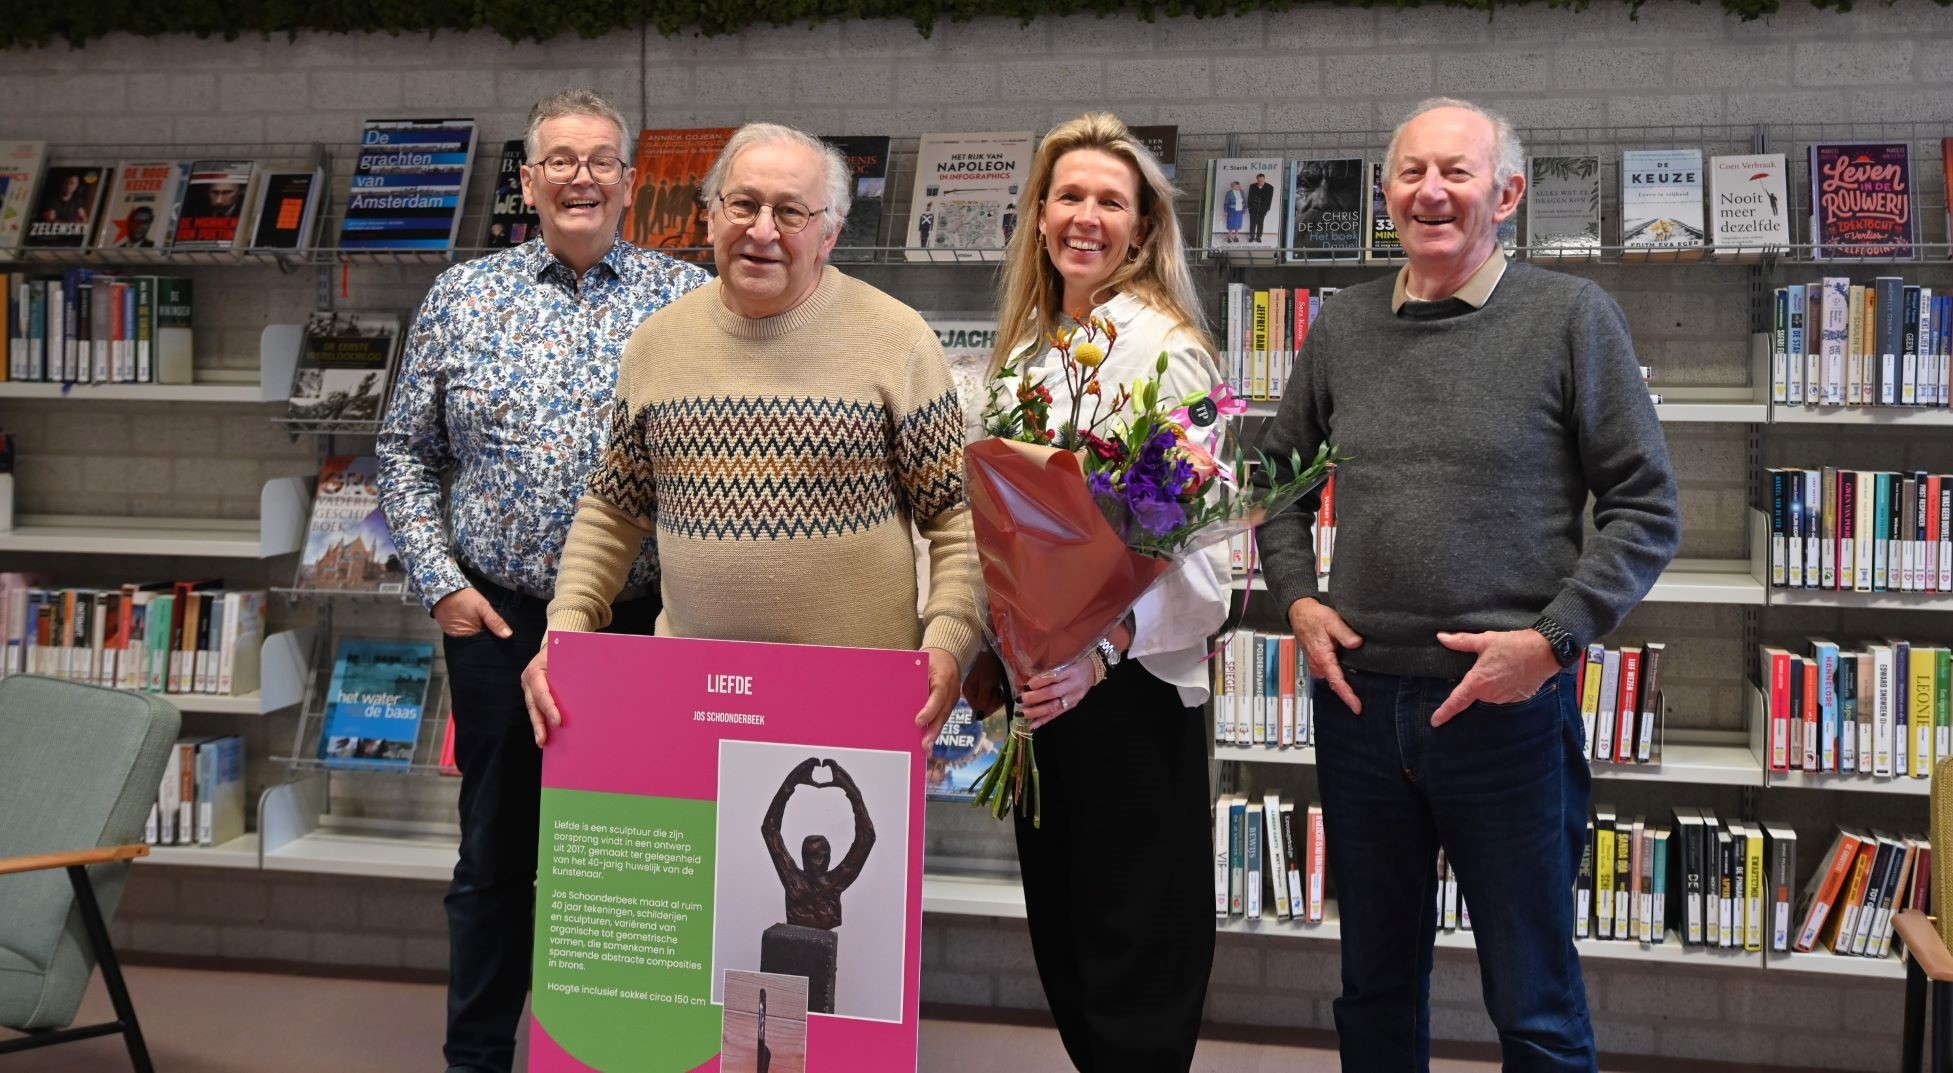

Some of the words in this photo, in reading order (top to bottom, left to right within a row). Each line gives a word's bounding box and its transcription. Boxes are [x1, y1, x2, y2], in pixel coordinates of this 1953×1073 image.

[366, 130, 389, 145] De
[360, 152, 432, 169] grachten
[937, 161, 1016, 172] NAPOLEON
[1251, 162, 1278, 171] Klaar
[950, 172, 1010, 180] INFOGRAPHICS
[1632, 173, 1695, 184] KEUZE
[1823, 155, 1904, 191] Leven
[357, 175, 384, 187] van
[1875, 183, 1891, 191] DE
[351, 193, 443, 208] Amsterdam
[1721, 193, 1763, 204] Nooit
[1721, 208, 1756, 217] meer
[1822, 190, 1909, 224] ROUWERIJ
[1322, 211, 1358, 221] CHRIS
[29, 222, 88, 236] ZELENSKY
[1299, 223, 1313, 232] DE
[1317, 221, 1358, 231] STOOP
[1376, 220, 1394, 230] 33
[1721, 219, 1780, 232] dezelfde
[1310, 232, 1328, 241] Het
[1331, 231, 1358, 240] boek
[1256, 304, 1265, 332] JEFFREY
[1905, 333, 1914, 350] GEEN
[707, 673, 752, 695] LIEFDE
[1225, 661, 1235, 695] SPIEGEL
[337, 690, 359, 703] het
[362, 693, 401, 705] water
[1879, 689, 1887, 717] SNOWDEN
[364, 705, 381, 718] de
[385, 704, 417, 719] baas
[693, 711, 705, 722] JOS
[706, 712, 765, 725] SCHOONDERBEEK
[555, 820, 580, 831] Liefde
[582, 822, 589, 831] is
[591, 825, 607, 833] een
[609, 825, 651, 837] sculptuur
[653, 829, 667, 838] die
[669, 830, 683, 841] zijn
[554, 833, 599, 845] oorsprong
[601, 836, 623, 846] vindt
[625, 838, 633, 847] in
[635, 840, 651, 848] een
[654, 840, 691, 852] ontwerp
[1248, 826, 1256, 858] BEWIJS
[554, 844, 565, 852] uit
[567, 845, 587, 855] 2017,
[589, 847, 629, 858] gemaakt
[631, 851, 642, 859] ter
[645, 851, 701, 864] gelegenheid
[553, 857, 570, 865] van
[572, 856, 586, 866] het
[588, 858, 623, 871] 40-jarig
[625, 861, 661, 873] huwelijk
[663, 865, 679, 874] van
[682, 865, 694, 875] de
[553, 867, 604, 879] kunstenaar.
[1736, 866, 1743, 874] DE
[1688, 874, 1698, 888] DE
[552, 890, 567, 899] Jos
[569, 891, 637, 905] Schoonderbeek
[640, 898, 668, 908] maakt
[671, 900, 680, 909] al
[682, 902, 702, 911] ruim
[552, 901, 562, 909] 40
[564, 903, 581, 913] jaar
[584, 904, 635, 918] tekeningen,
[637, 909, 688, 923] schilderijen
[550, 913, 561, 921] en
[564, 914, 612, 927] sculpturen,
[614, 918, 657, 930] variërend
[659, 923, 676, 932] van
[550, 925, 599, 937] organische
[602, 929, 614, 937] tot
[616, 930, 678, 944] geometrische
[550, 937, 585, 948] vormen,
[587, 939, 601, 948] die
[603, 942, 665, 954] samenkomen
[667, 946, 675, 955] in
[549, 947, 604, 959] spannende
[601, 952, 644, 964] abstracte
[647, 957, 702, 970] composities
[549, 959, 557, 967] in
[559, 960, 586, 971] brons.
[548, 982, 580, 994] Hoogte
[582, 984, 618, 997] inclusief
[620, 987, 648, 999] sokkel
[650, 993, 672, 1002] circa
[674, 994, 688, 1004] 150
[691, 998, 705, 1006] cm
